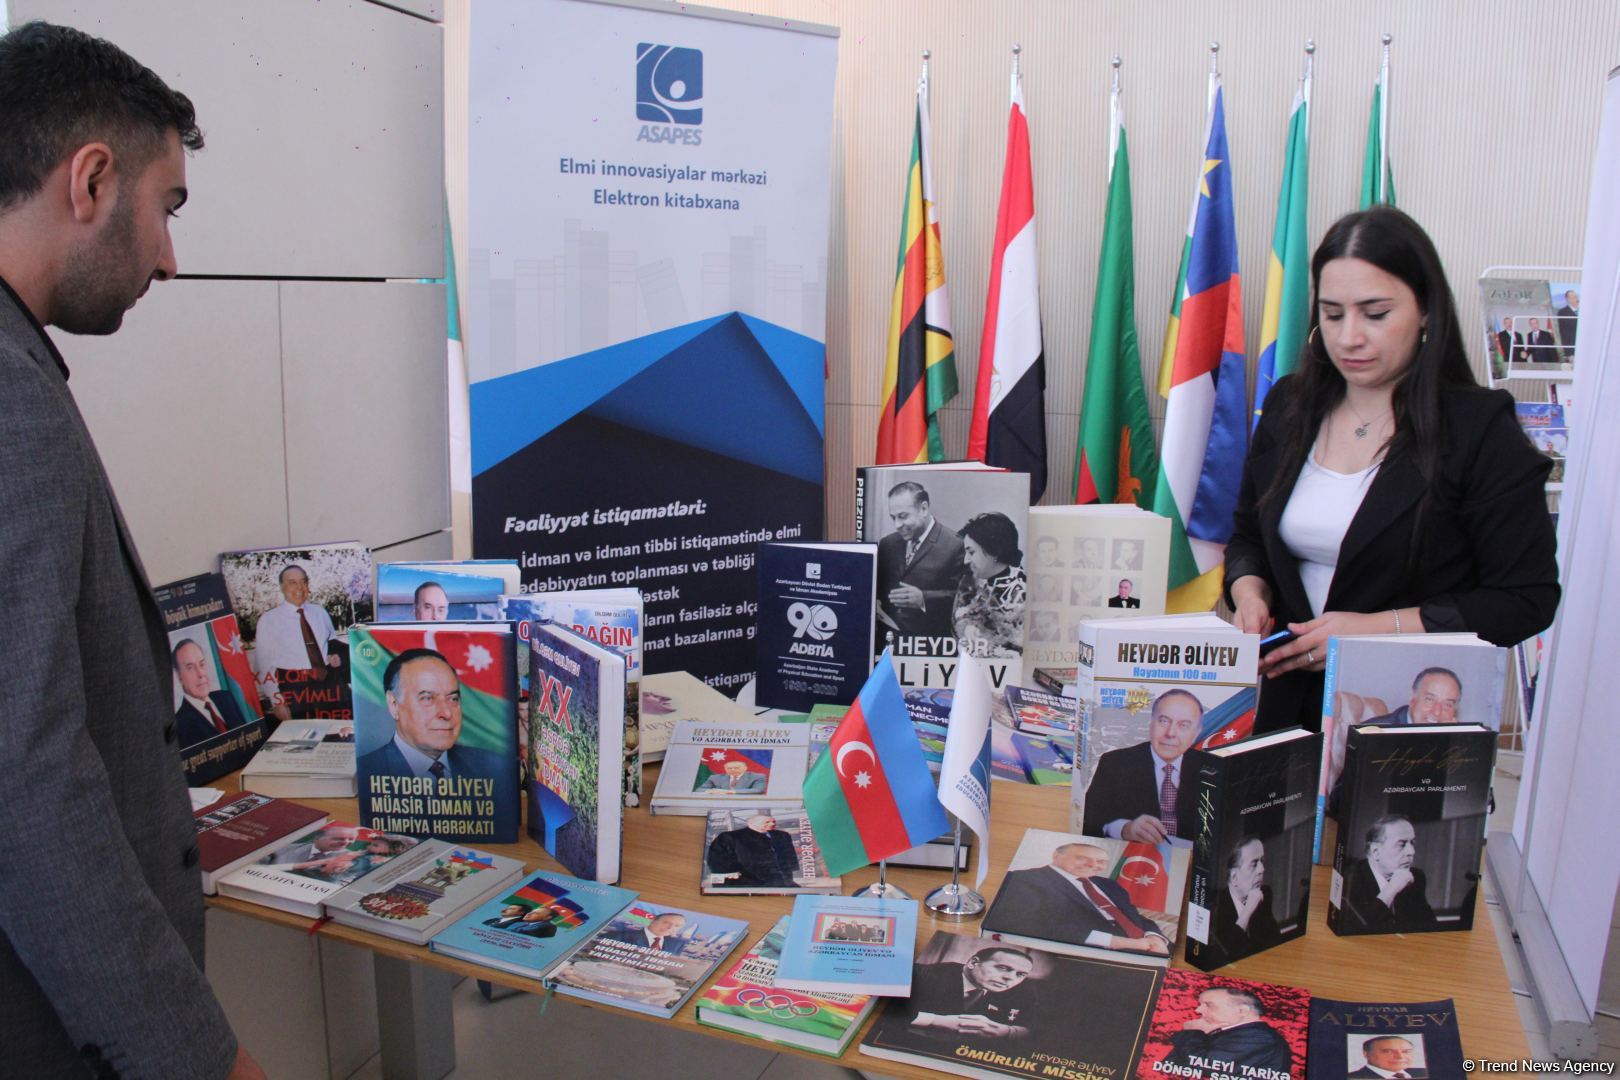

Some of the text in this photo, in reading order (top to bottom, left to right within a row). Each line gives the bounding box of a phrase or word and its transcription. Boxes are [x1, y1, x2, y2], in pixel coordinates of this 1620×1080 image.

[636, 125, 703, 146] ASAPES
[560, 158, 767, 185] Elmi innovasiyalar mərkəzi
[593, 189, 740, 210] Elektron kitabxana
[504, 499, 707, 534] Fəaliyyət istiqamətləri:
[856, 477, 864, 542] PREZIDE
[521, 523, 801, 568] İdman və idman tibbi istiqamətində elmi
[520, 553, 755, 594] ədəbiyyatın toplanması və təbliği
[642, 613, 675, 627] ların
[679, 603, 733, 622] fasiləsiz
[674, 629, 743, 647] bazalarına
[789, 642, 834, 659] ADBTİA
[1118, 642, 1239, 667] HEYDƏR ƏLİYEV
[1133, 667, 1217, 681] Həyatının 100 anı
[538, 668, 573, 735] XX
[693, 727, 792, 738] HEYDƏR ƏLİYEV
[705, 736, 758, 744] AZƏRBAYCAN
[760, 736, 791, 745] İDMANI
[370, 775, 494, 797] HEYDƏR ƏLİYEV
[371, 795, 495, 816] MÜASİR İDMAN VƏ
[372, 815, 495, 836] OLİMPİYA HƏRƏKATI
[1319, 1011, 1451, 1027] ALIYEV
[955, 1045, 1038, 1072] ÖMÜRLÜK
[1030, 1052, 1117, 1077] HEYDƏR ƏLİYEV
[1152, 1060, 1202, 1079] DÖNƏN
[1188, 1055, 1291, 1080] TALEYİ TARİXƏ
